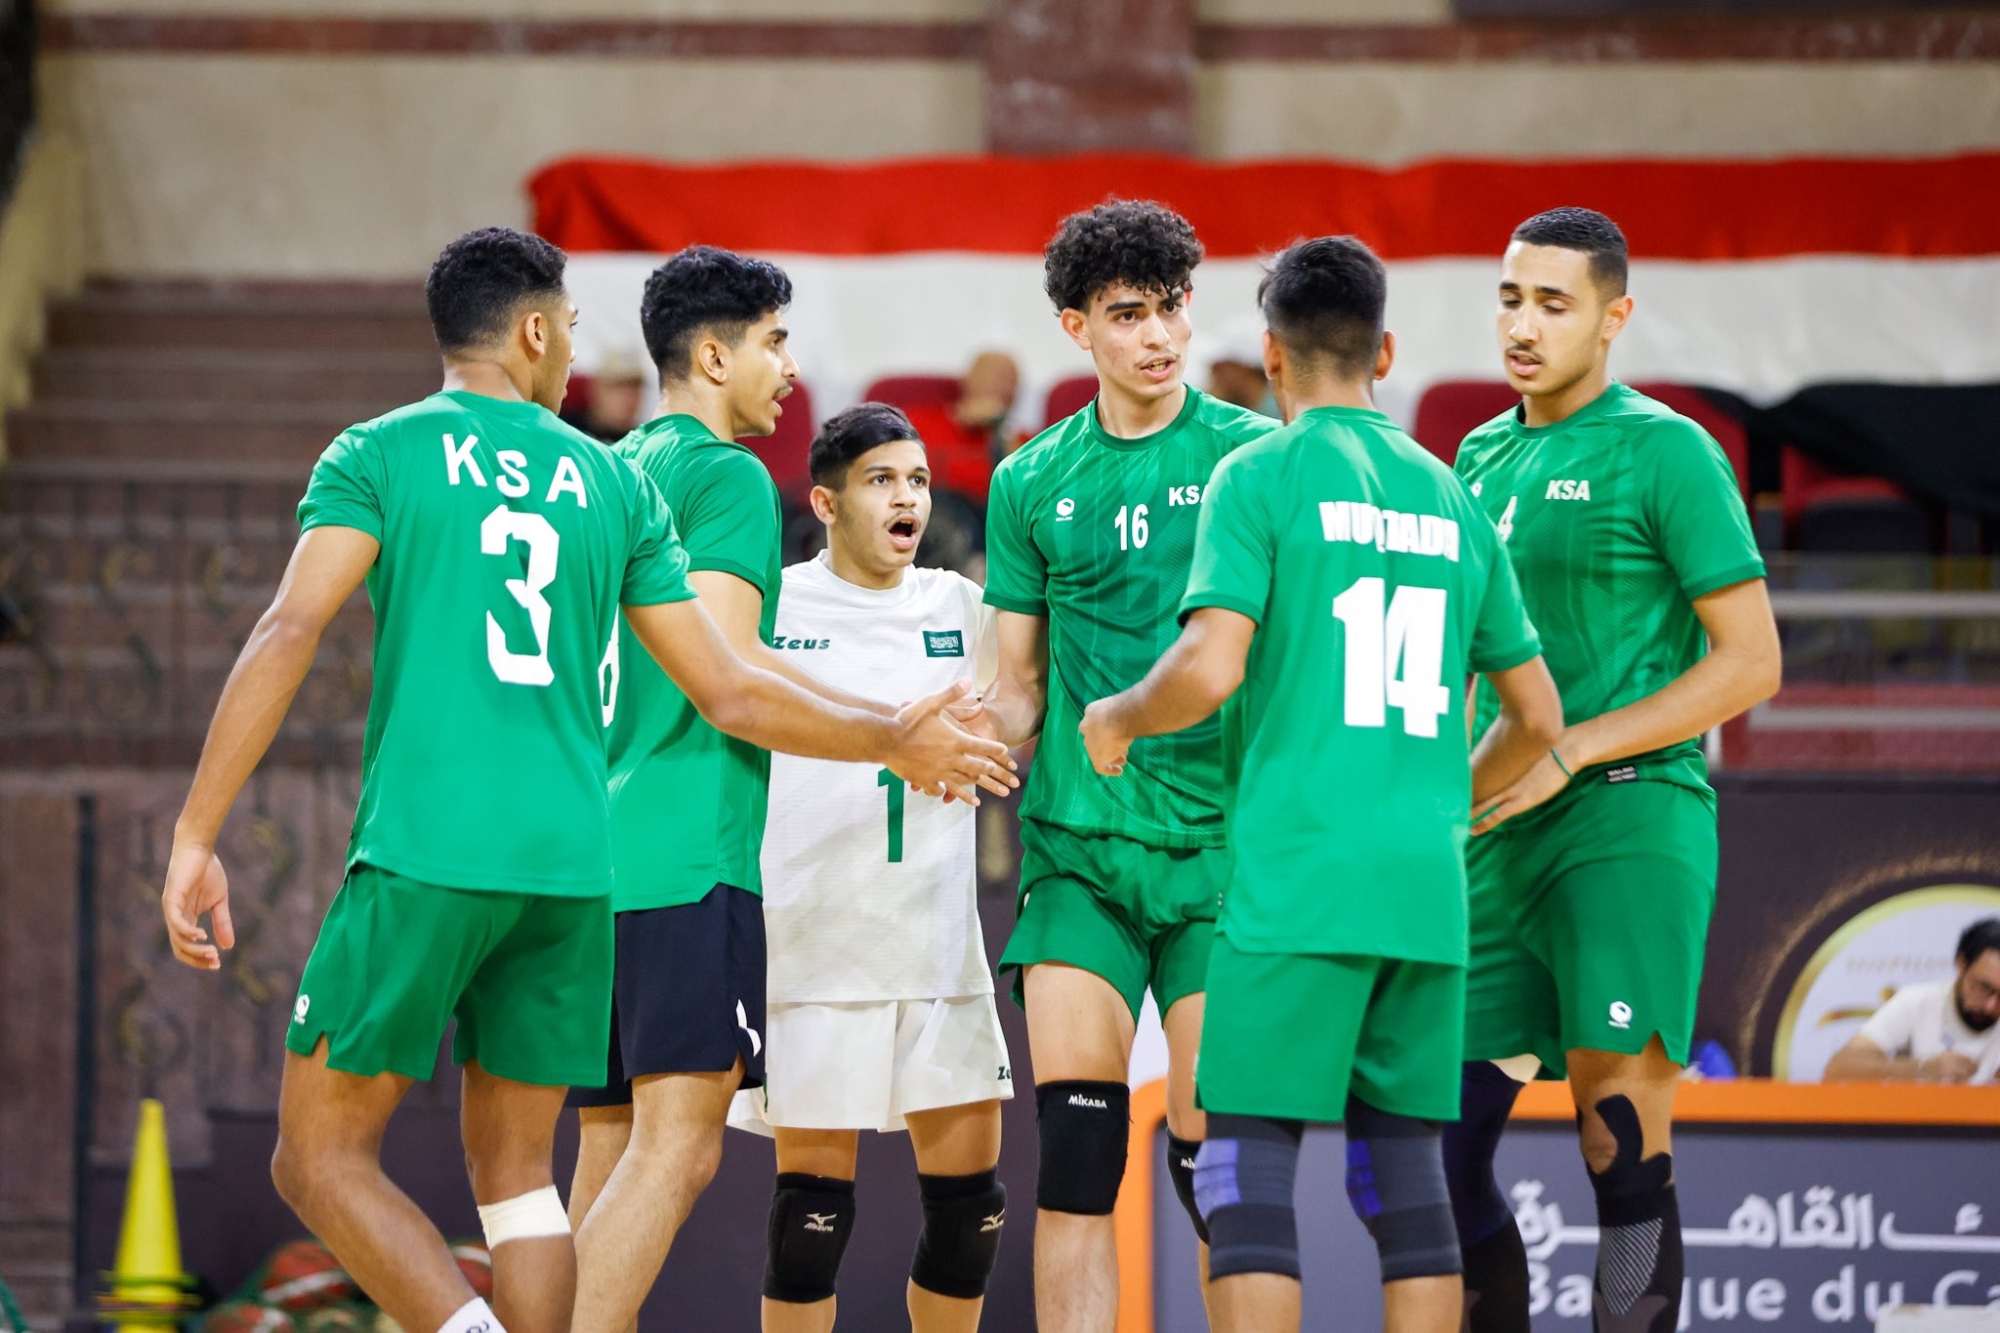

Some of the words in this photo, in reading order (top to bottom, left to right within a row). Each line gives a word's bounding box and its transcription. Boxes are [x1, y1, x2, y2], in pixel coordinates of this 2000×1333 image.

[442, 433, 588, 509] KSA
[1544, 479, 1591, 501] KSA
[1114, 503, 1149, 551] 16
[481, 504, 560, 687] 3
[773, 635, 830, 650] Zeus
[1332, 576, 1450, 739] 14
[878, 767, 905, 863] 1
[1529, 1261, 1787, 1332] Baue
[1811, 1264, 1905, 1324] du
[1932, 1269, 2000, 1310] C
